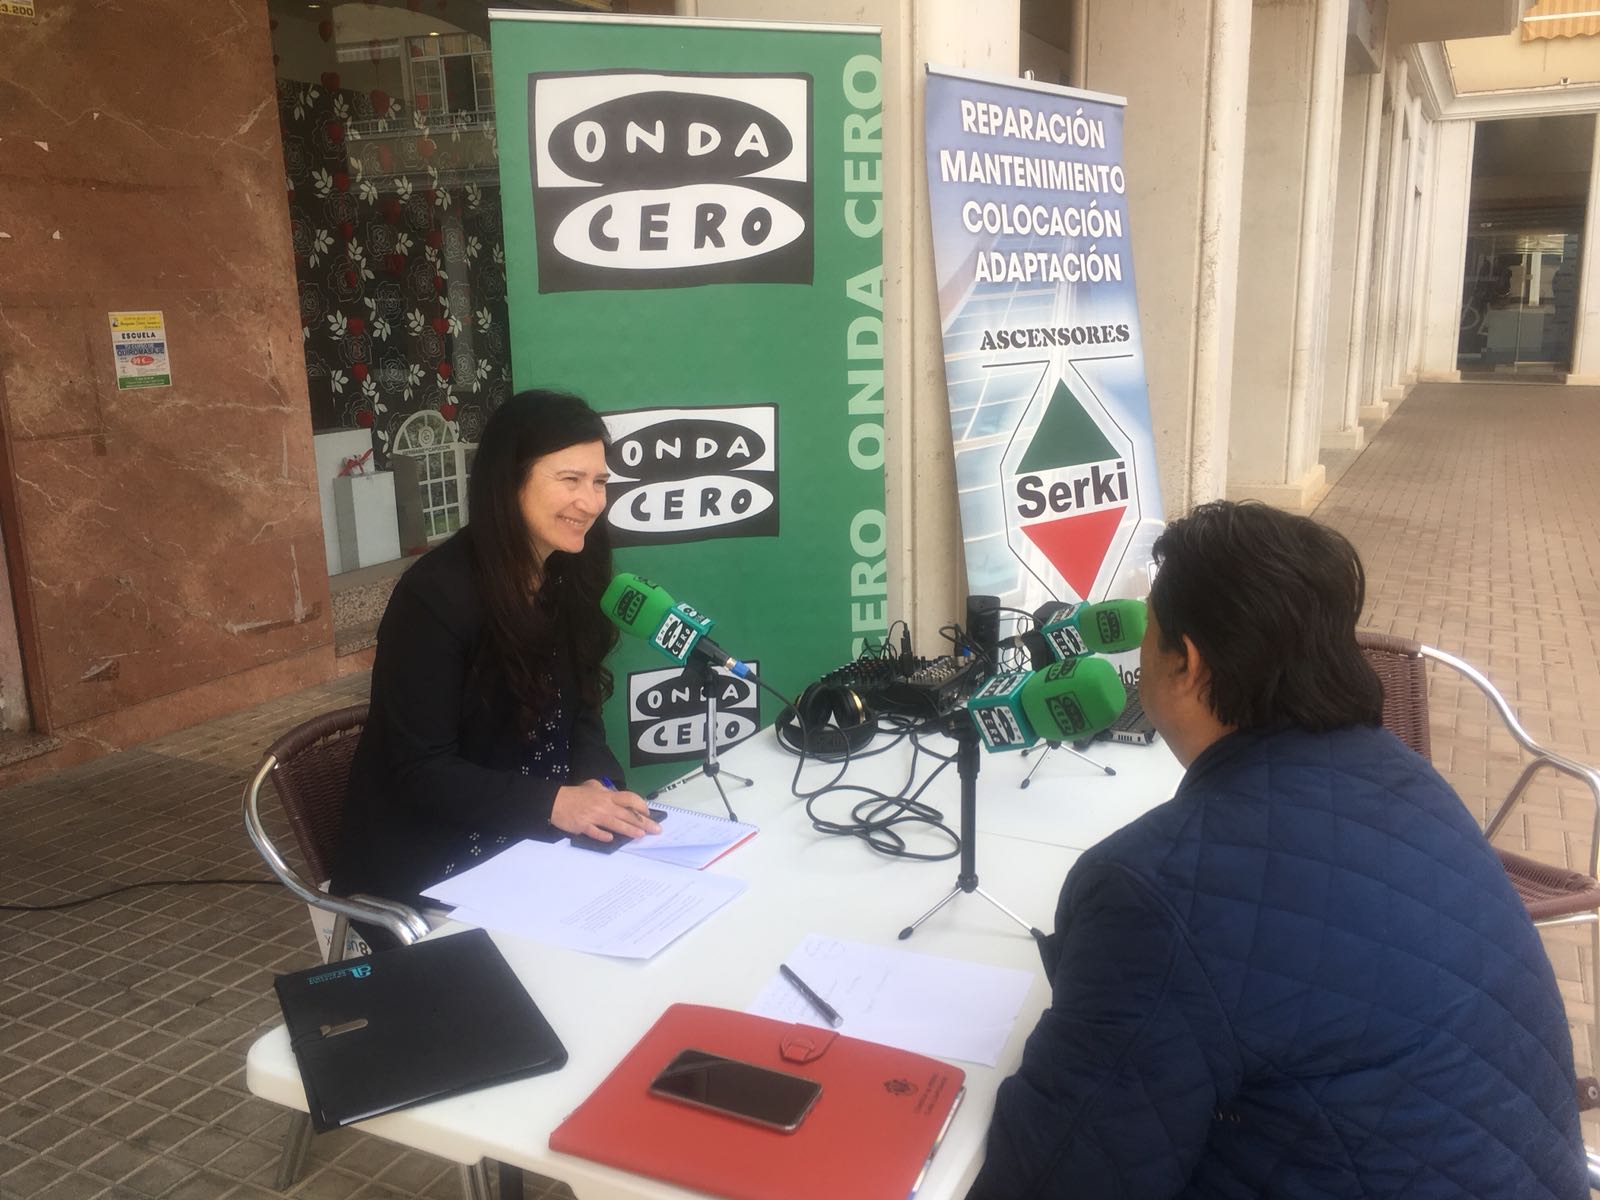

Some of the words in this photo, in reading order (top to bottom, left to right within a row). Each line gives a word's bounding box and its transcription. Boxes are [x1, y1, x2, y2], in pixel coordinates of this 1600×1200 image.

[573, 119, 770, 163] ONDA
[960, 99, 1105, 149] REPARACIÓN
[842, 54, 883, 239] CERO
[939, 149, 1126, 195] MANTENIMIENTO
[588, 201, 773, 253] CERO
[962, 199, 1123, 238] COLOCACIÓN
[974, 244, 1122, 283] ADAPTACIÓN
[979, 323, 1130, 351] ASCENSORES
[846, 264, 885, 471] ONDA
[621, 435, 751, 467] ONDA
[630, 486, 753, 523] CERO
[1015, 460, 1130, 520] Serki
[671, 628, 692, 656] CERO
[1052, 631, 1070, 657] CERO
[979, 709, 1002, 744] CERO
